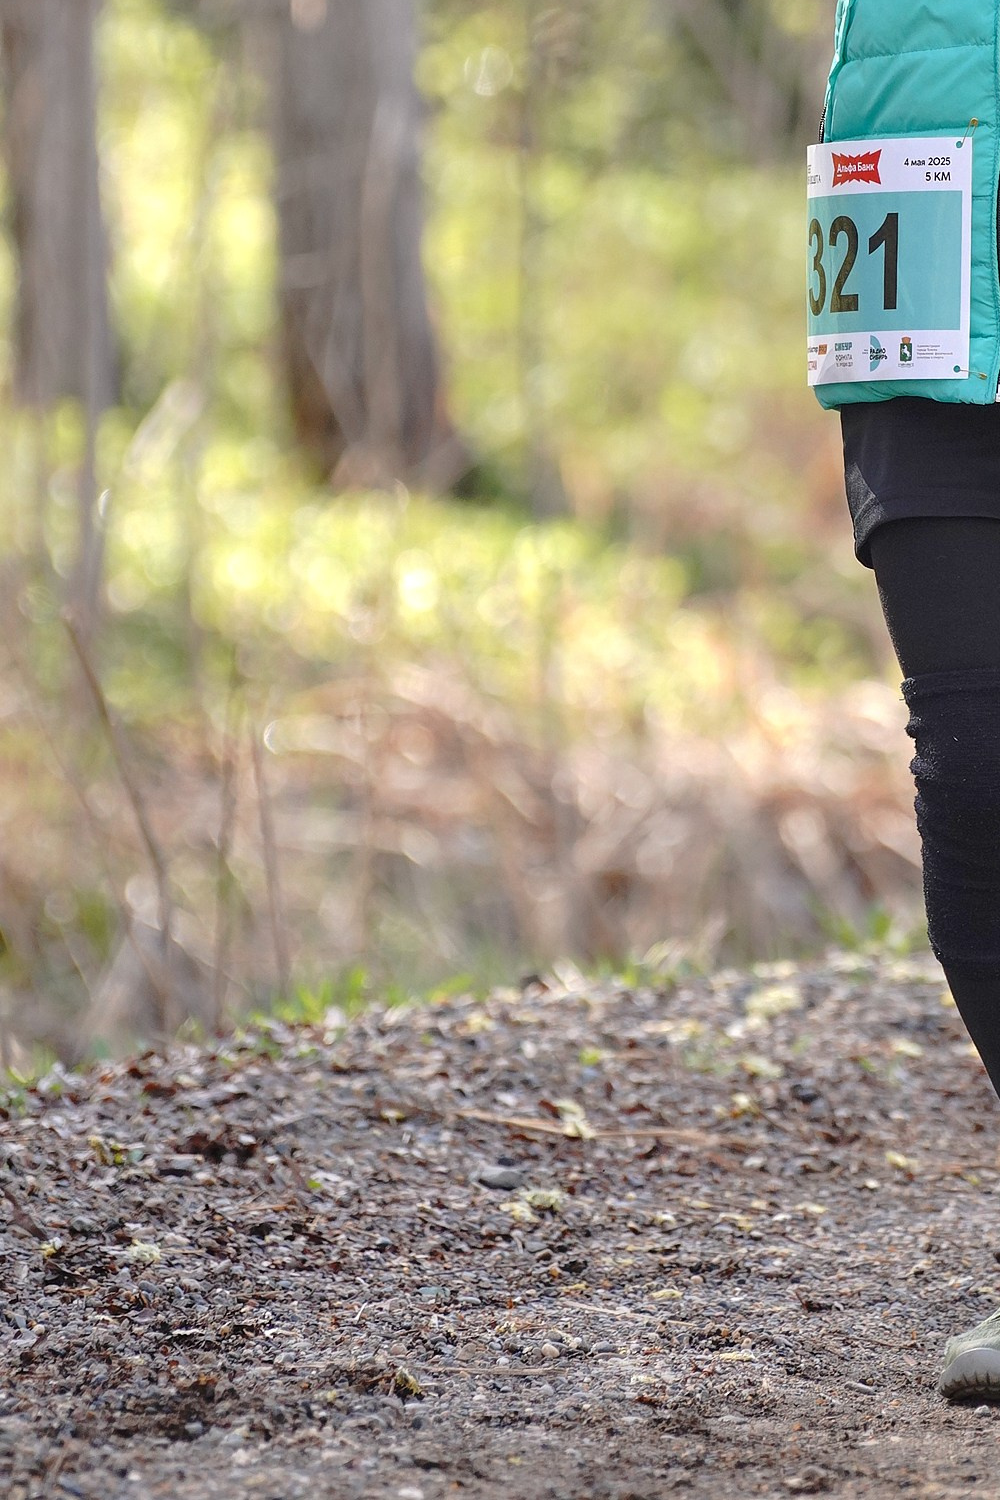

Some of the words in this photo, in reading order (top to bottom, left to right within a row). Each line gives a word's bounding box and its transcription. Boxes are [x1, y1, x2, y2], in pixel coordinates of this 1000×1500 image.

[904, 158, 910, 167] 4
[911, 159, 926, 167] мая
[928, 156, 951, 166] 2025
[836, 163, 857, 175] Альфа
[857, 161, 875, 172] Банк
[925, 172, 932, 182] 5
[808, 212, 899, 317] 321
